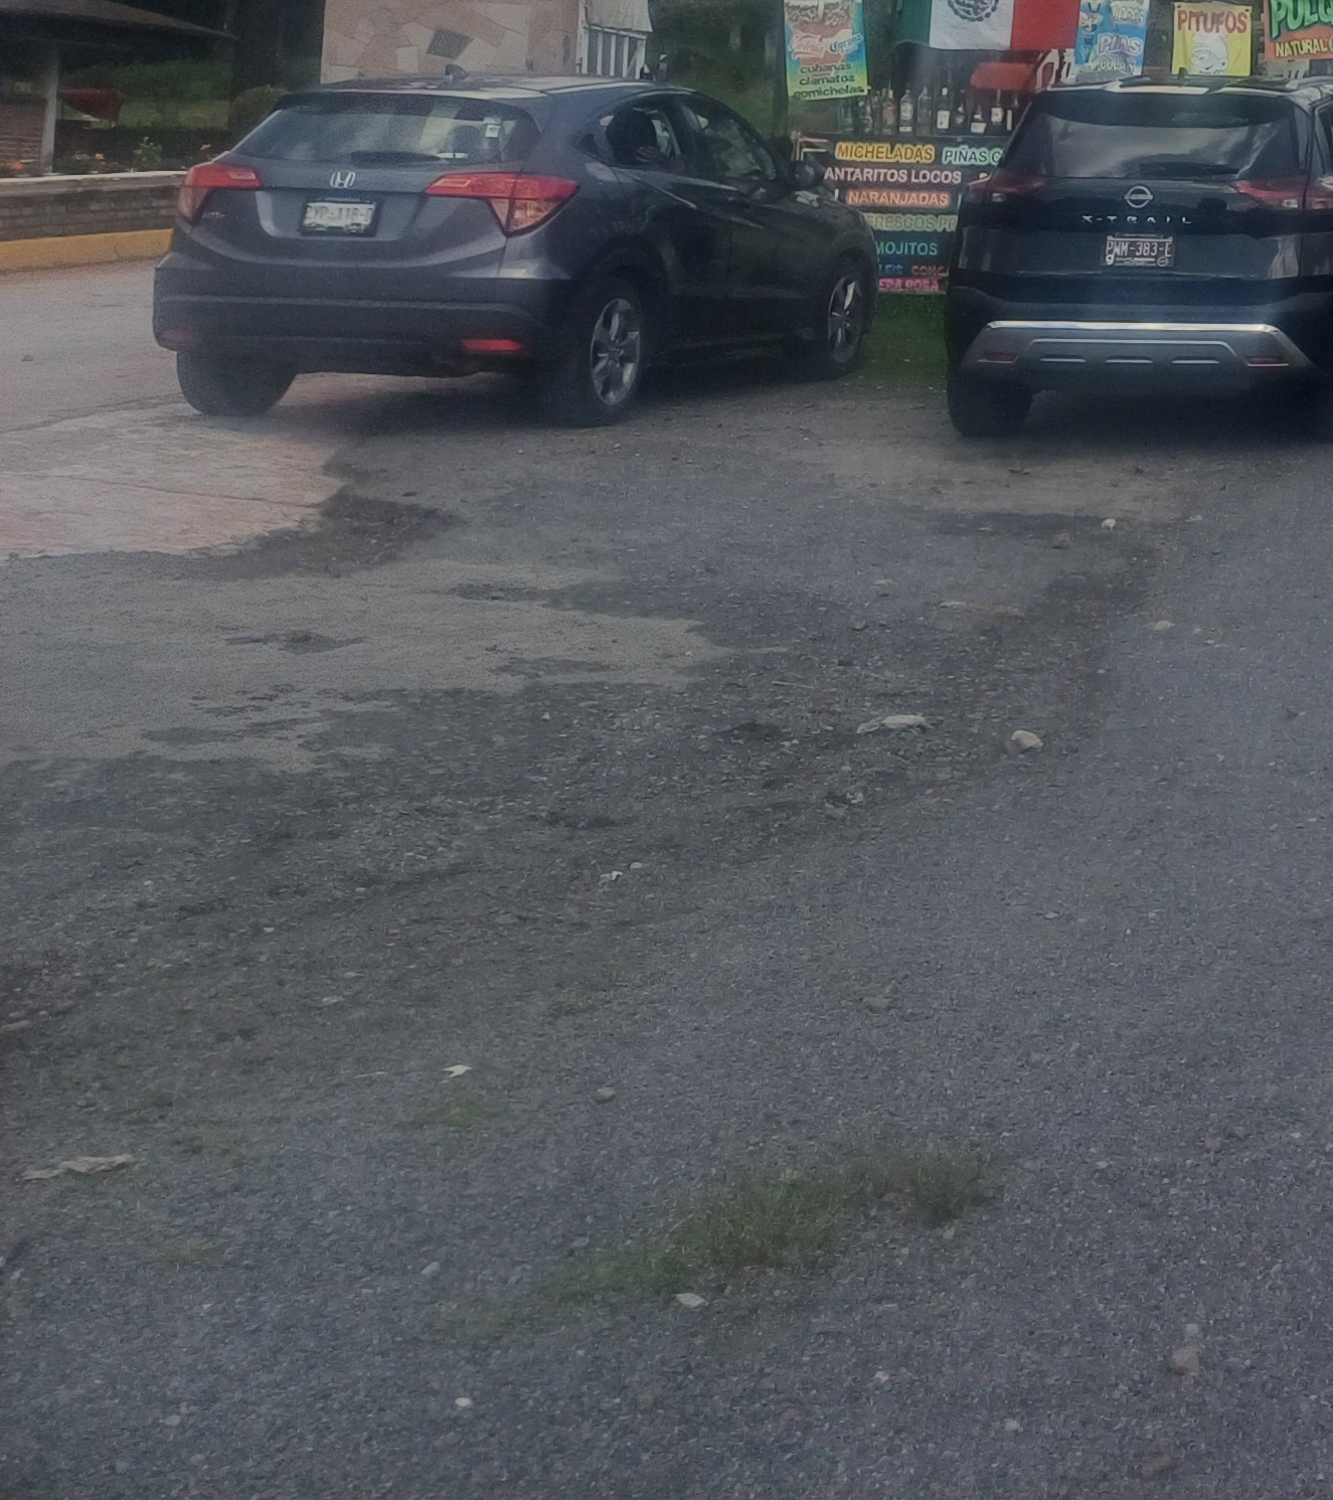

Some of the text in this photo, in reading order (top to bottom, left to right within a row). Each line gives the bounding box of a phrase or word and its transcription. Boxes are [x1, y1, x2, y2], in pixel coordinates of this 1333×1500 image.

[1177, 9, 1249, 35] PITUFOS
[1275, 38, 1328, 58] NATURAL
[800, 62, 852, 75] cubanas
[799, 73, 855, 87] clamatos
[837, 144, 934, 162] MICHELADAS
[944, 145, 988, 164] PIÑAS
[824, 166, 962, 184] ANTARITOS LOCOS
[849, 190, 950, 206] NARANJADAS
[1081, 215, 1192, 224] X-TRAIL
[877, 241, 938, 256] MOJITOS
